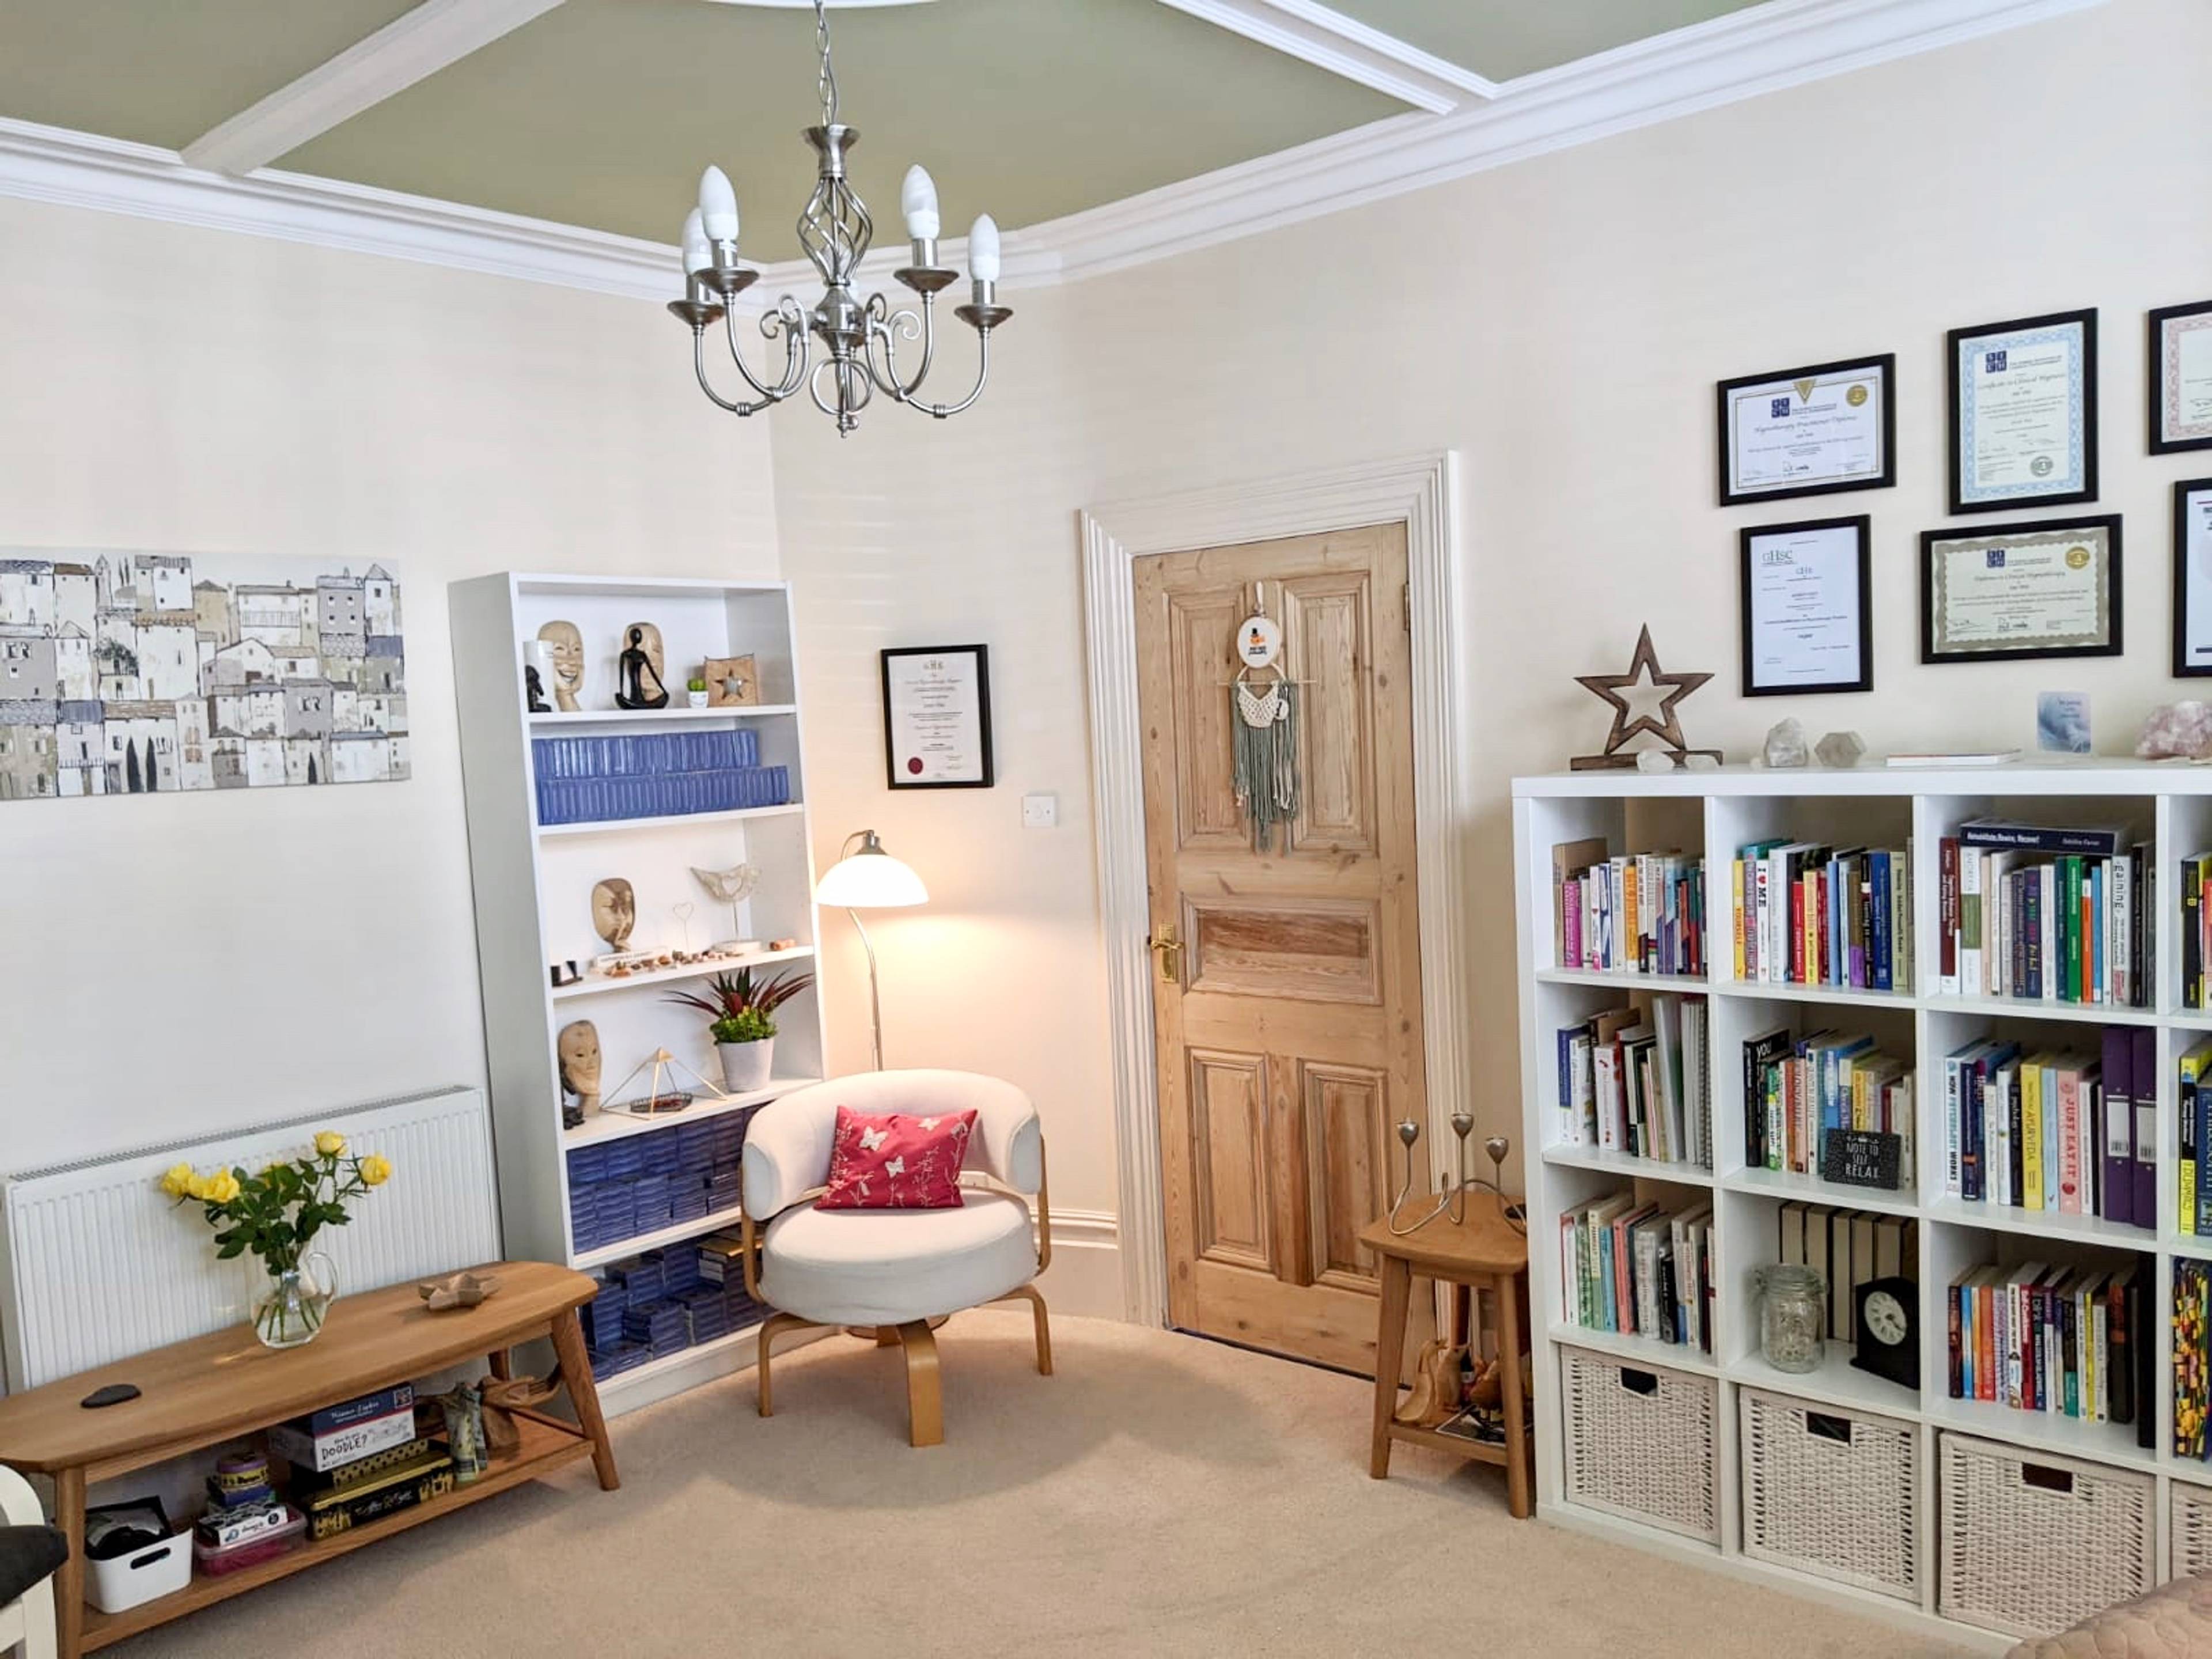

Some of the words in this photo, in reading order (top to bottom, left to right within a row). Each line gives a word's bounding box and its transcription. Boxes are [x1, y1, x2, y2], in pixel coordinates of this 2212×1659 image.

[1758, 887, 1767, 908] ME
[2066, 1097, 2075, 1131] JUST
[1846, 1142, 1866, 1154] NOTE
[2066, 1135, 2076, 1161] EAT
[2067, 1164, 2077, 1178] IT
[321, 1434, 367, 1460] DOODLE?
